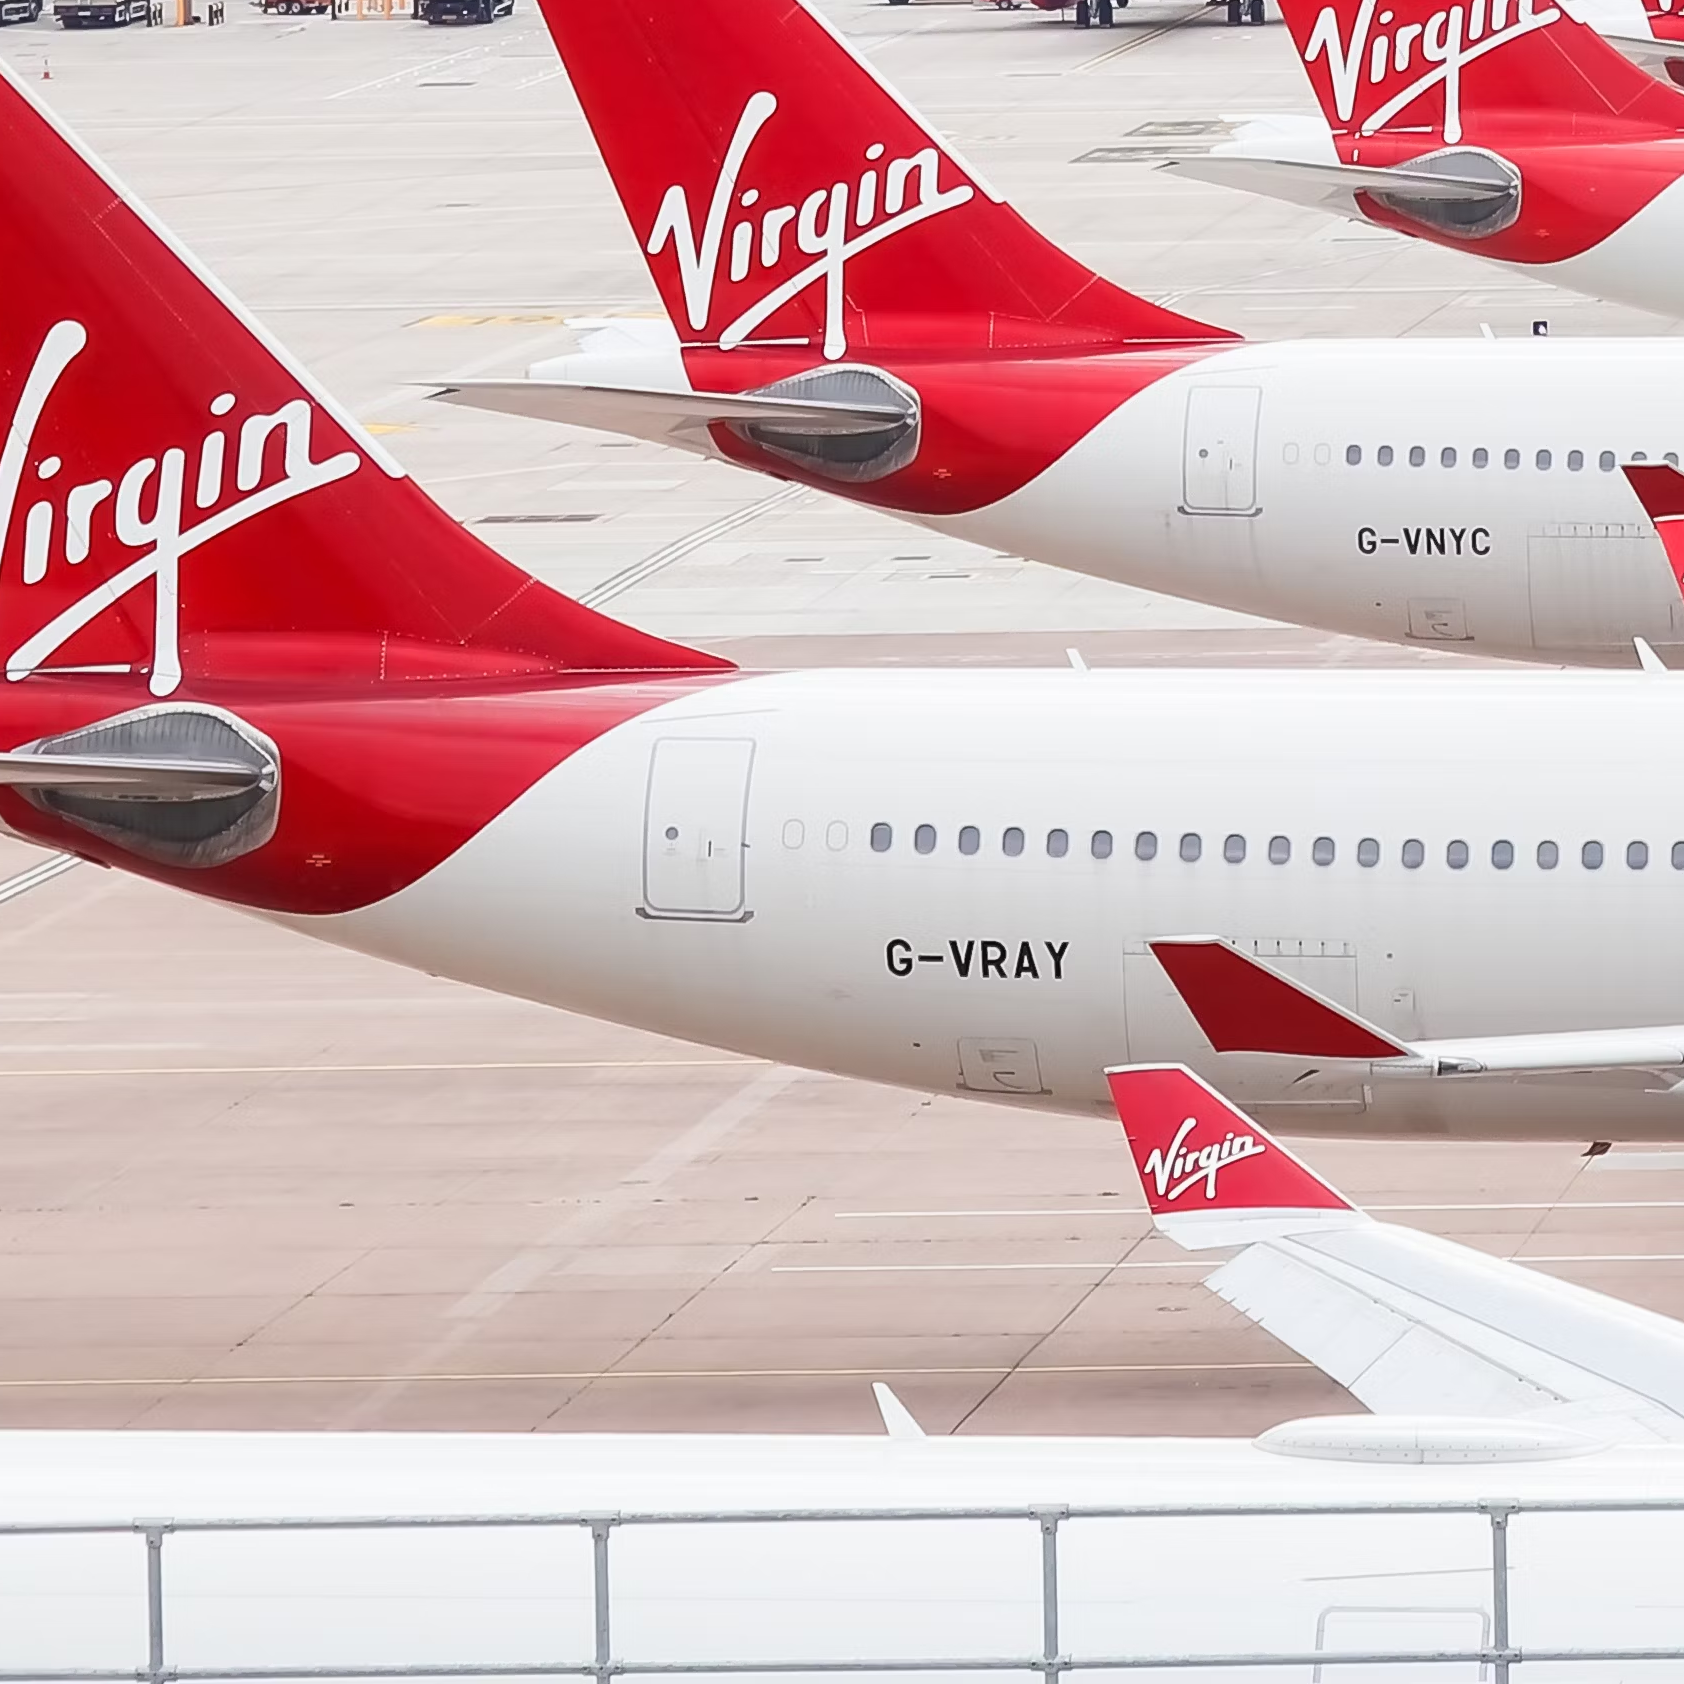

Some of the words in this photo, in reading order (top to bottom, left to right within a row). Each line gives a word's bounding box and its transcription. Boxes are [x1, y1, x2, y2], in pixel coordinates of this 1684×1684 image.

[647, 91, 974, 361] Virgin
[1357, 527, 1491, 556] G-VNYC
[886, 938, 1069, 980] G-VRAY
[1143, 1117, 1266, 1199] Virgin
